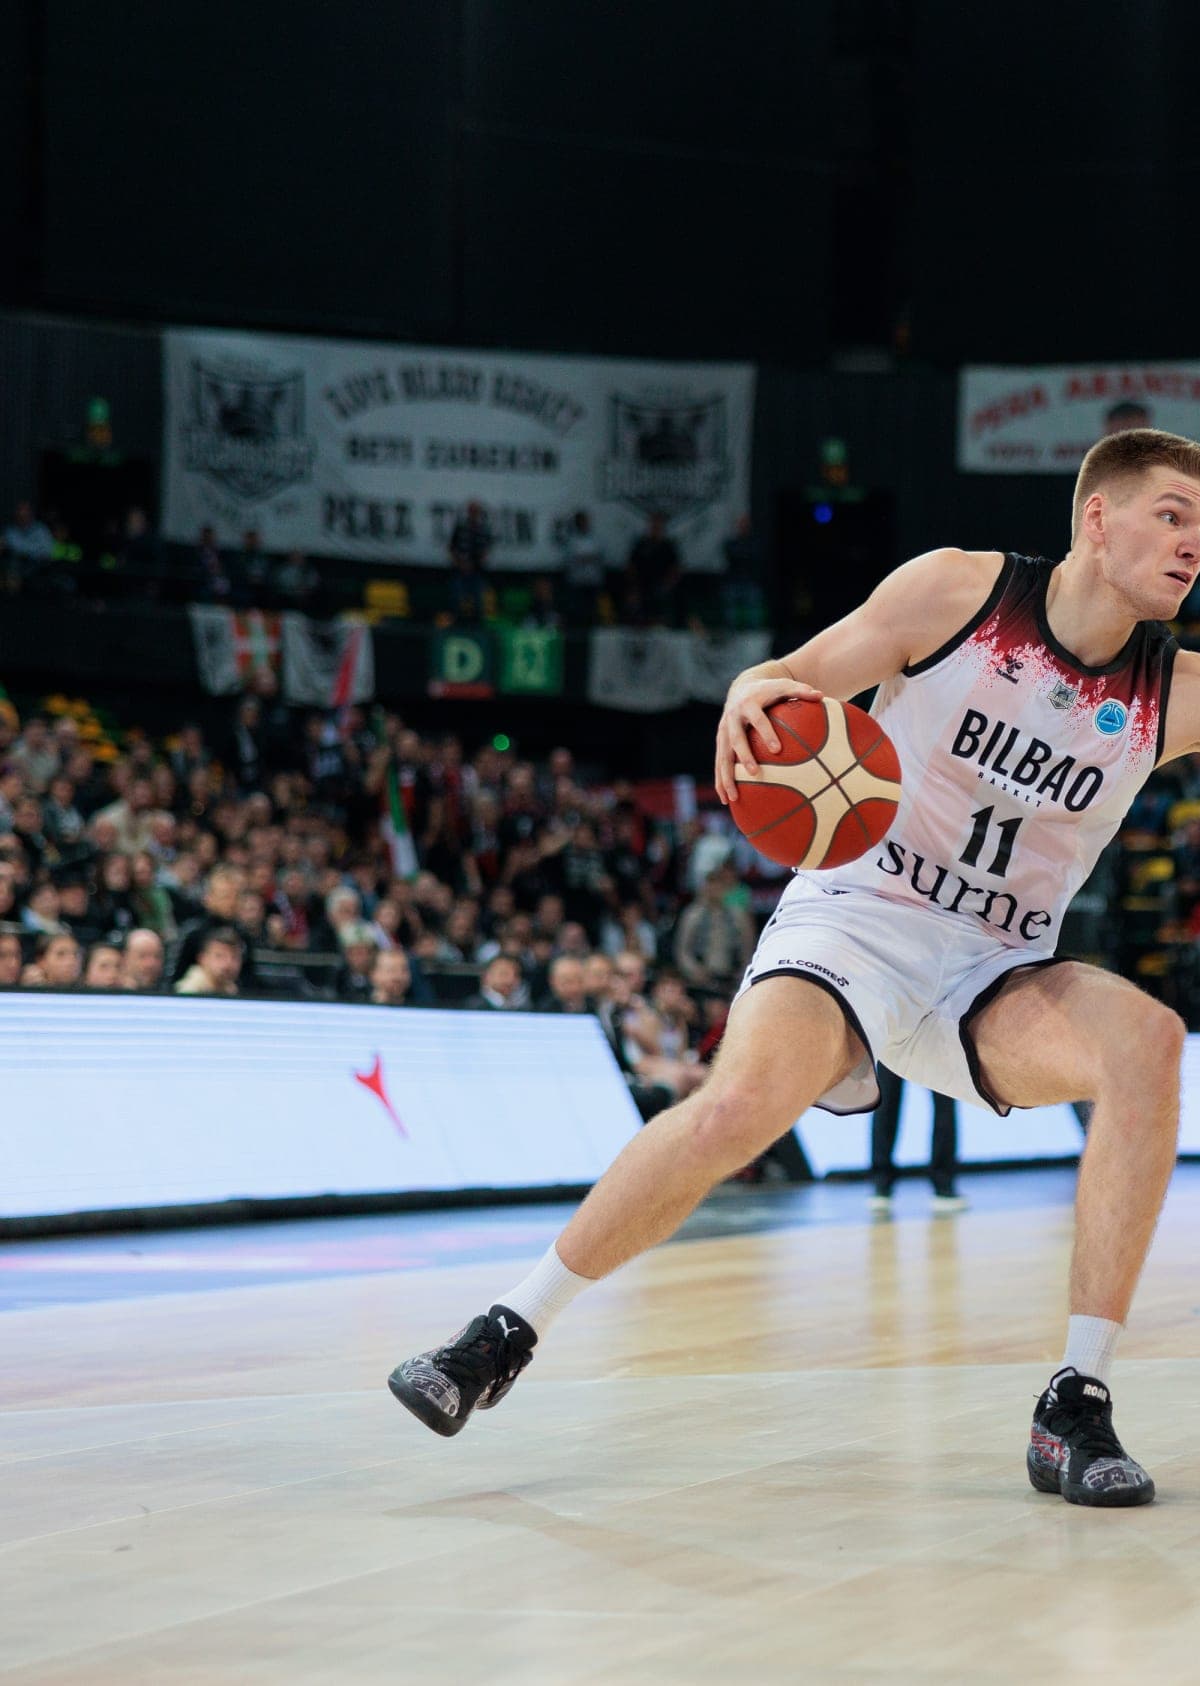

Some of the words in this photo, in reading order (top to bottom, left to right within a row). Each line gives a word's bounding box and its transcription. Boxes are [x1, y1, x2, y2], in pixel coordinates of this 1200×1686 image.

[951, 708, 1104, 812] BILBAO
[977, 771, 1043, 809] BASKET
[958, 804, 1024, 879] 11
[876, 838, 1052, 942] surne
[796, 959, 847, 988] CORREO
